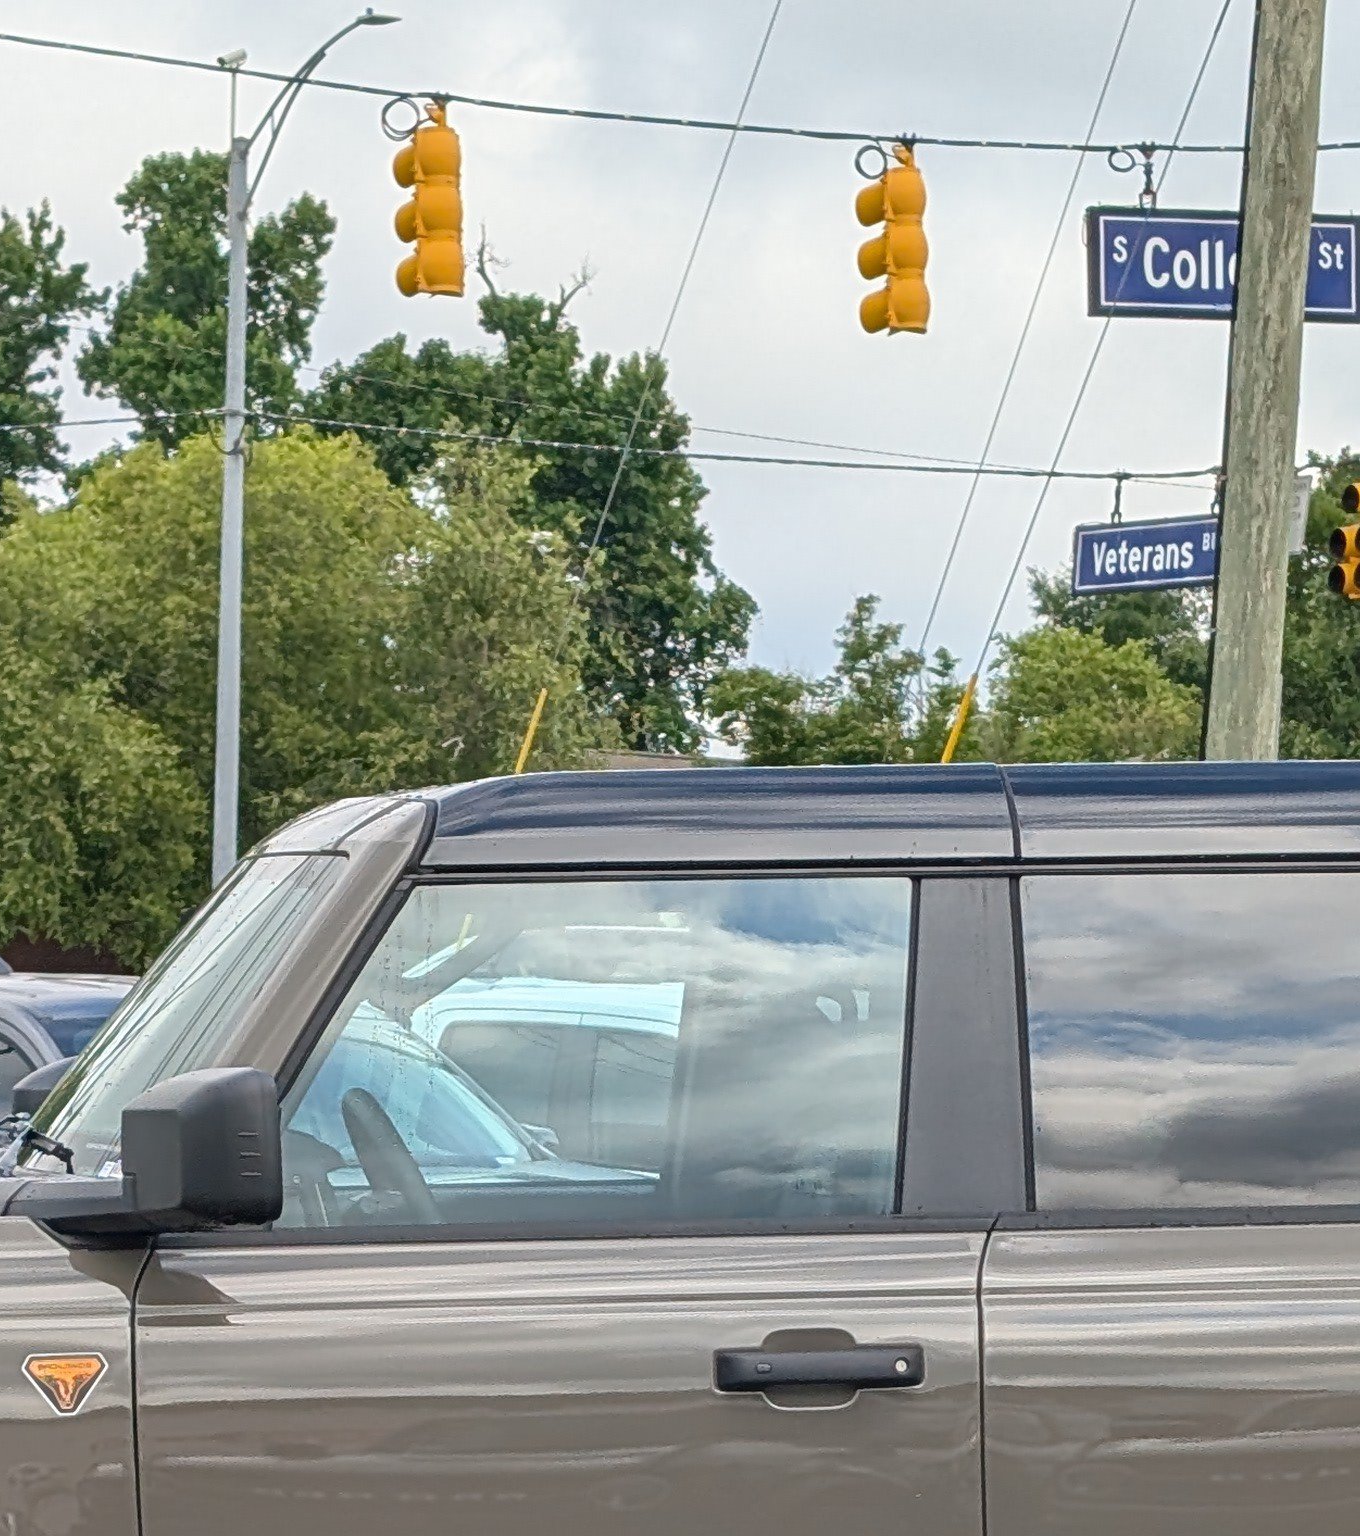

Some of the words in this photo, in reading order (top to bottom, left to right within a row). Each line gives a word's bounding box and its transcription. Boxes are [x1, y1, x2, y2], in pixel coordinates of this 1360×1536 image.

[1112, 235, 1128, 263] S
[1318, 242, 1344, 270] St
[1093, 539, 1194, 577] Veterans
